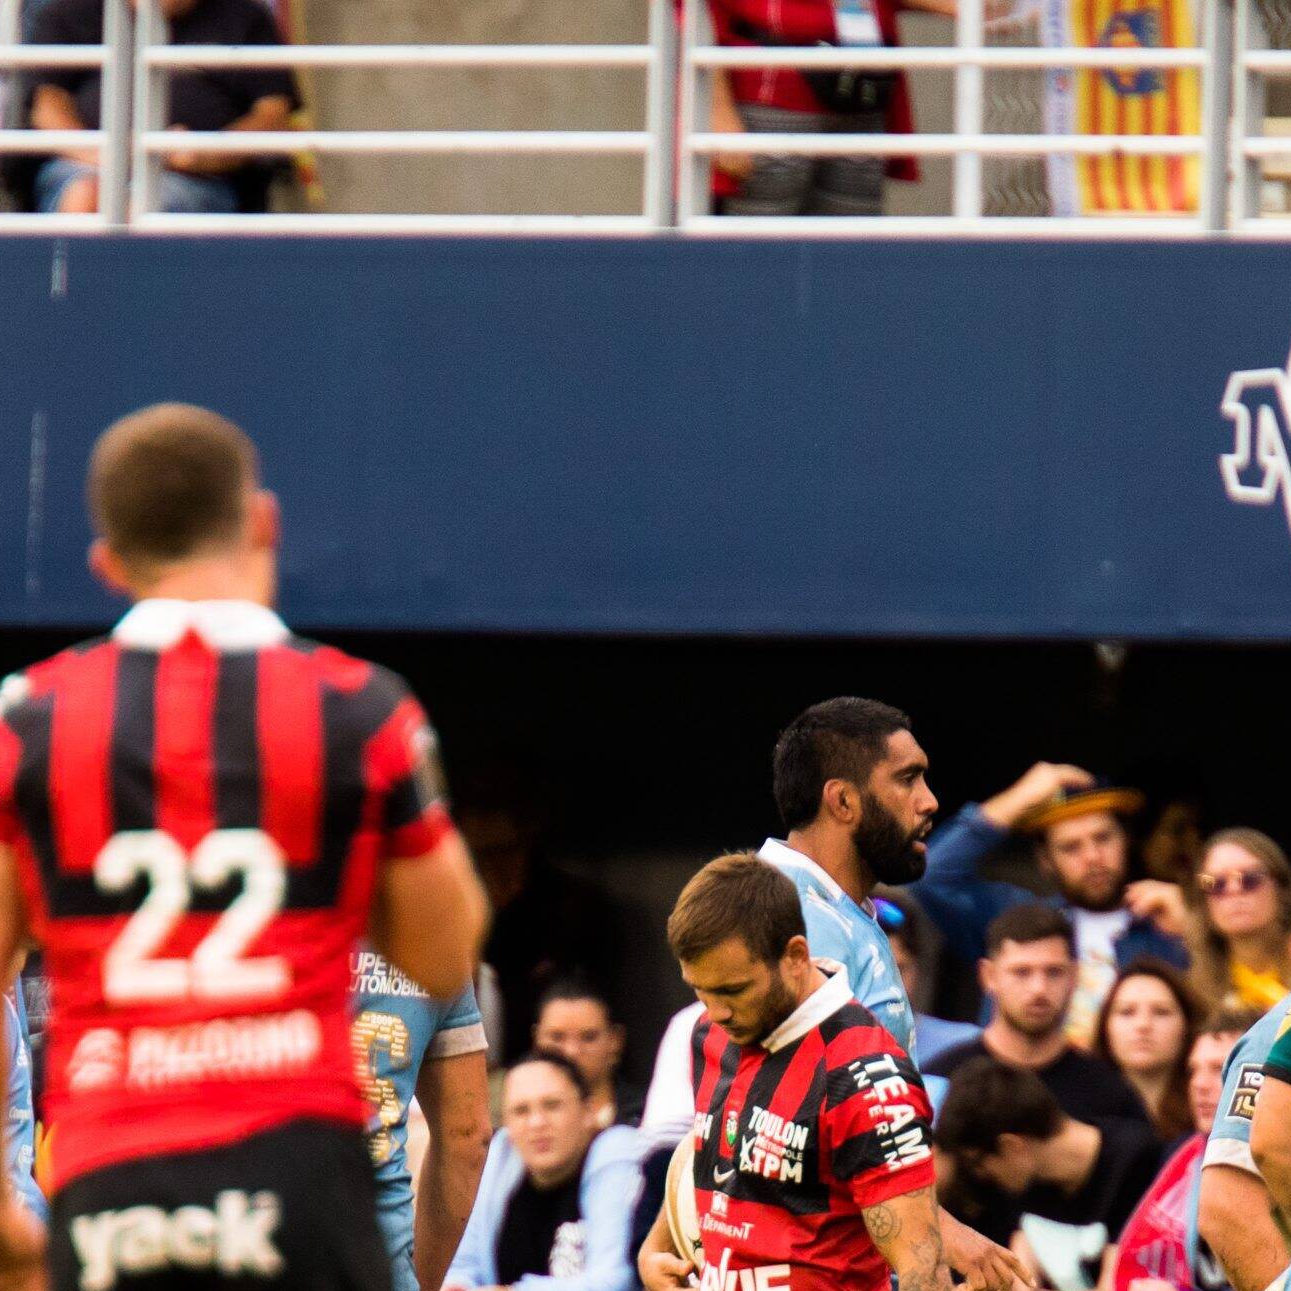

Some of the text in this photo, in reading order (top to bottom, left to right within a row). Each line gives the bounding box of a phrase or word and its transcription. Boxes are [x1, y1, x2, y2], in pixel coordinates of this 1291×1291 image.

[94, 826, 292, 1007] 22
[748, 1105, 809, 1150] TOULON
[752, 1146, 803, 1183] TPM
[847, 1061, 903, 1173] INTERIM
[863, 1053, 933, 1170] TEAM
